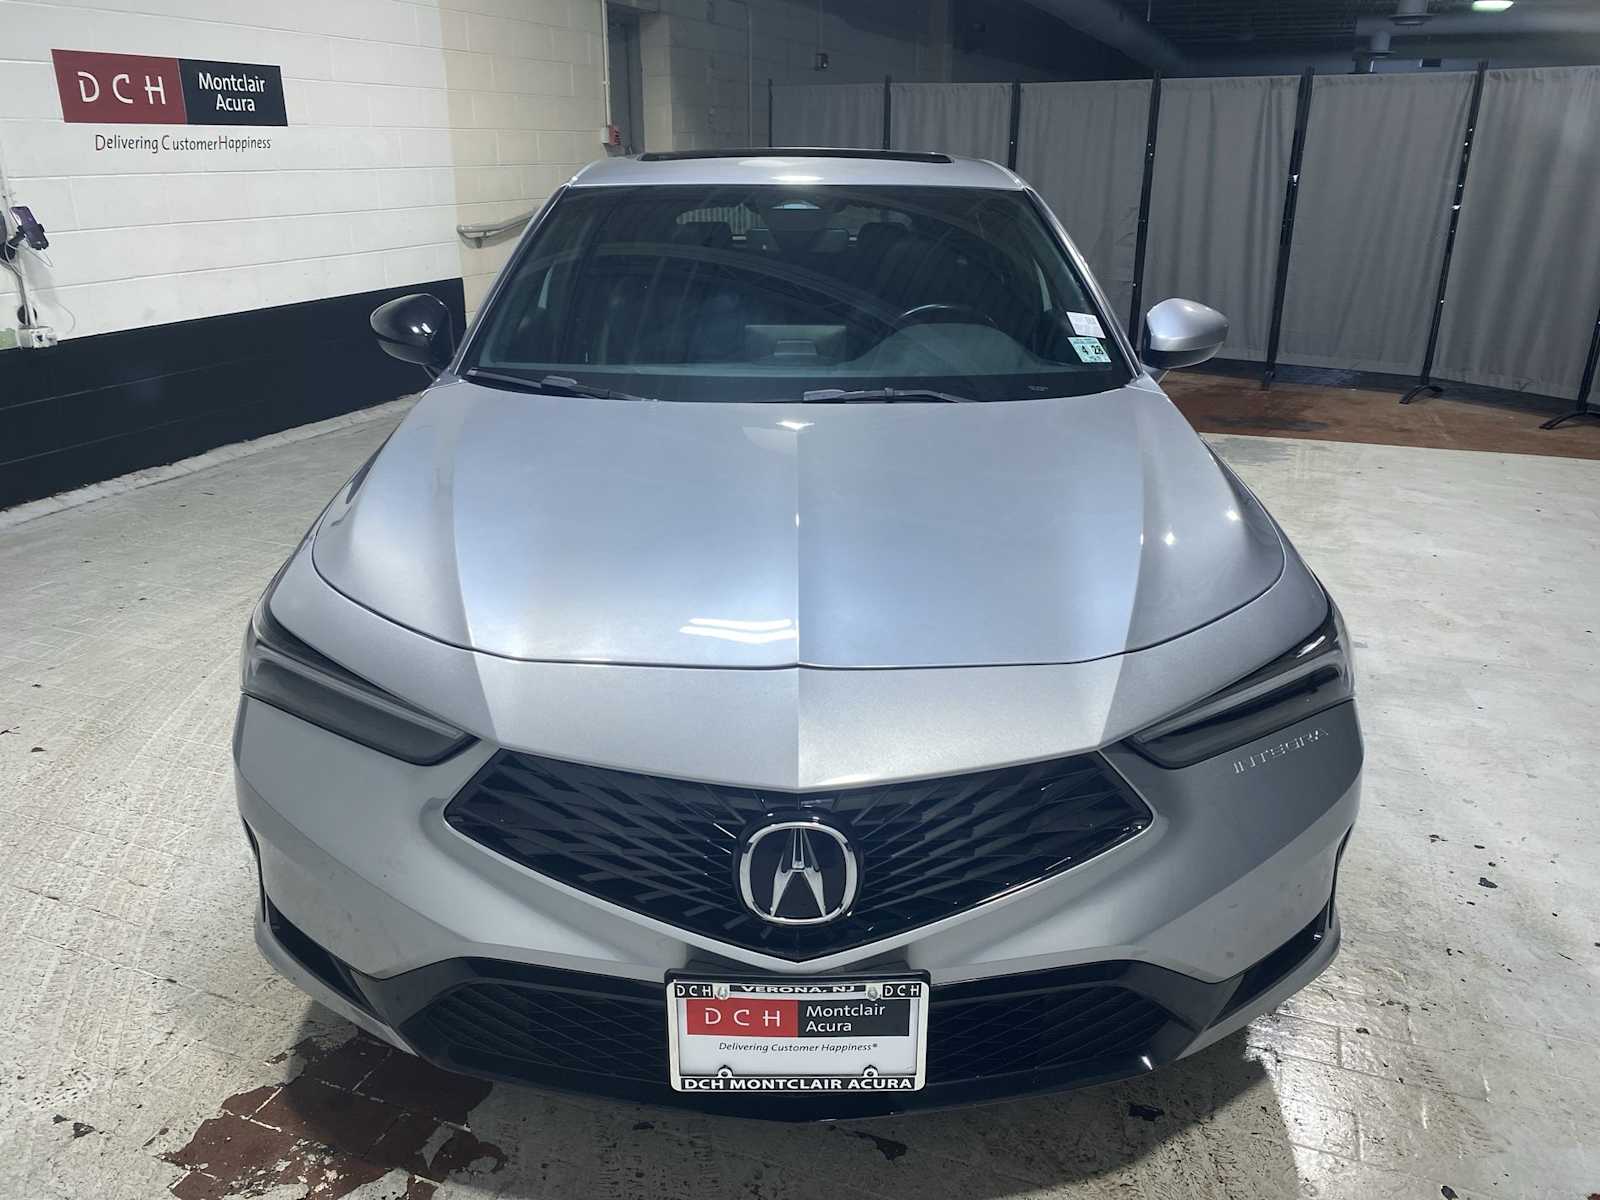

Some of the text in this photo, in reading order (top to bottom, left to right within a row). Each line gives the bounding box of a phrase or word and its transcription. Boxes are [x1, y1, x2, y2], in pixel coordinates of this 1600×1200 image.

[198, 72, 266, 93] Montclair
[215, 93, 256, 112] Acura
[95, 134, 272, 153] Delivering Customer Happiness
[832, 985, 857, 993] NJ
[806, 1003, 886, 1018] Montclair
[806, 1020, 852, 1033] Acura
[719, 1042, 769, 1053] Delivering
[771, 1042, 819, 1053] Customer
[684, 1077, 913, 1090] DCH MONTCLAIR ACURA
